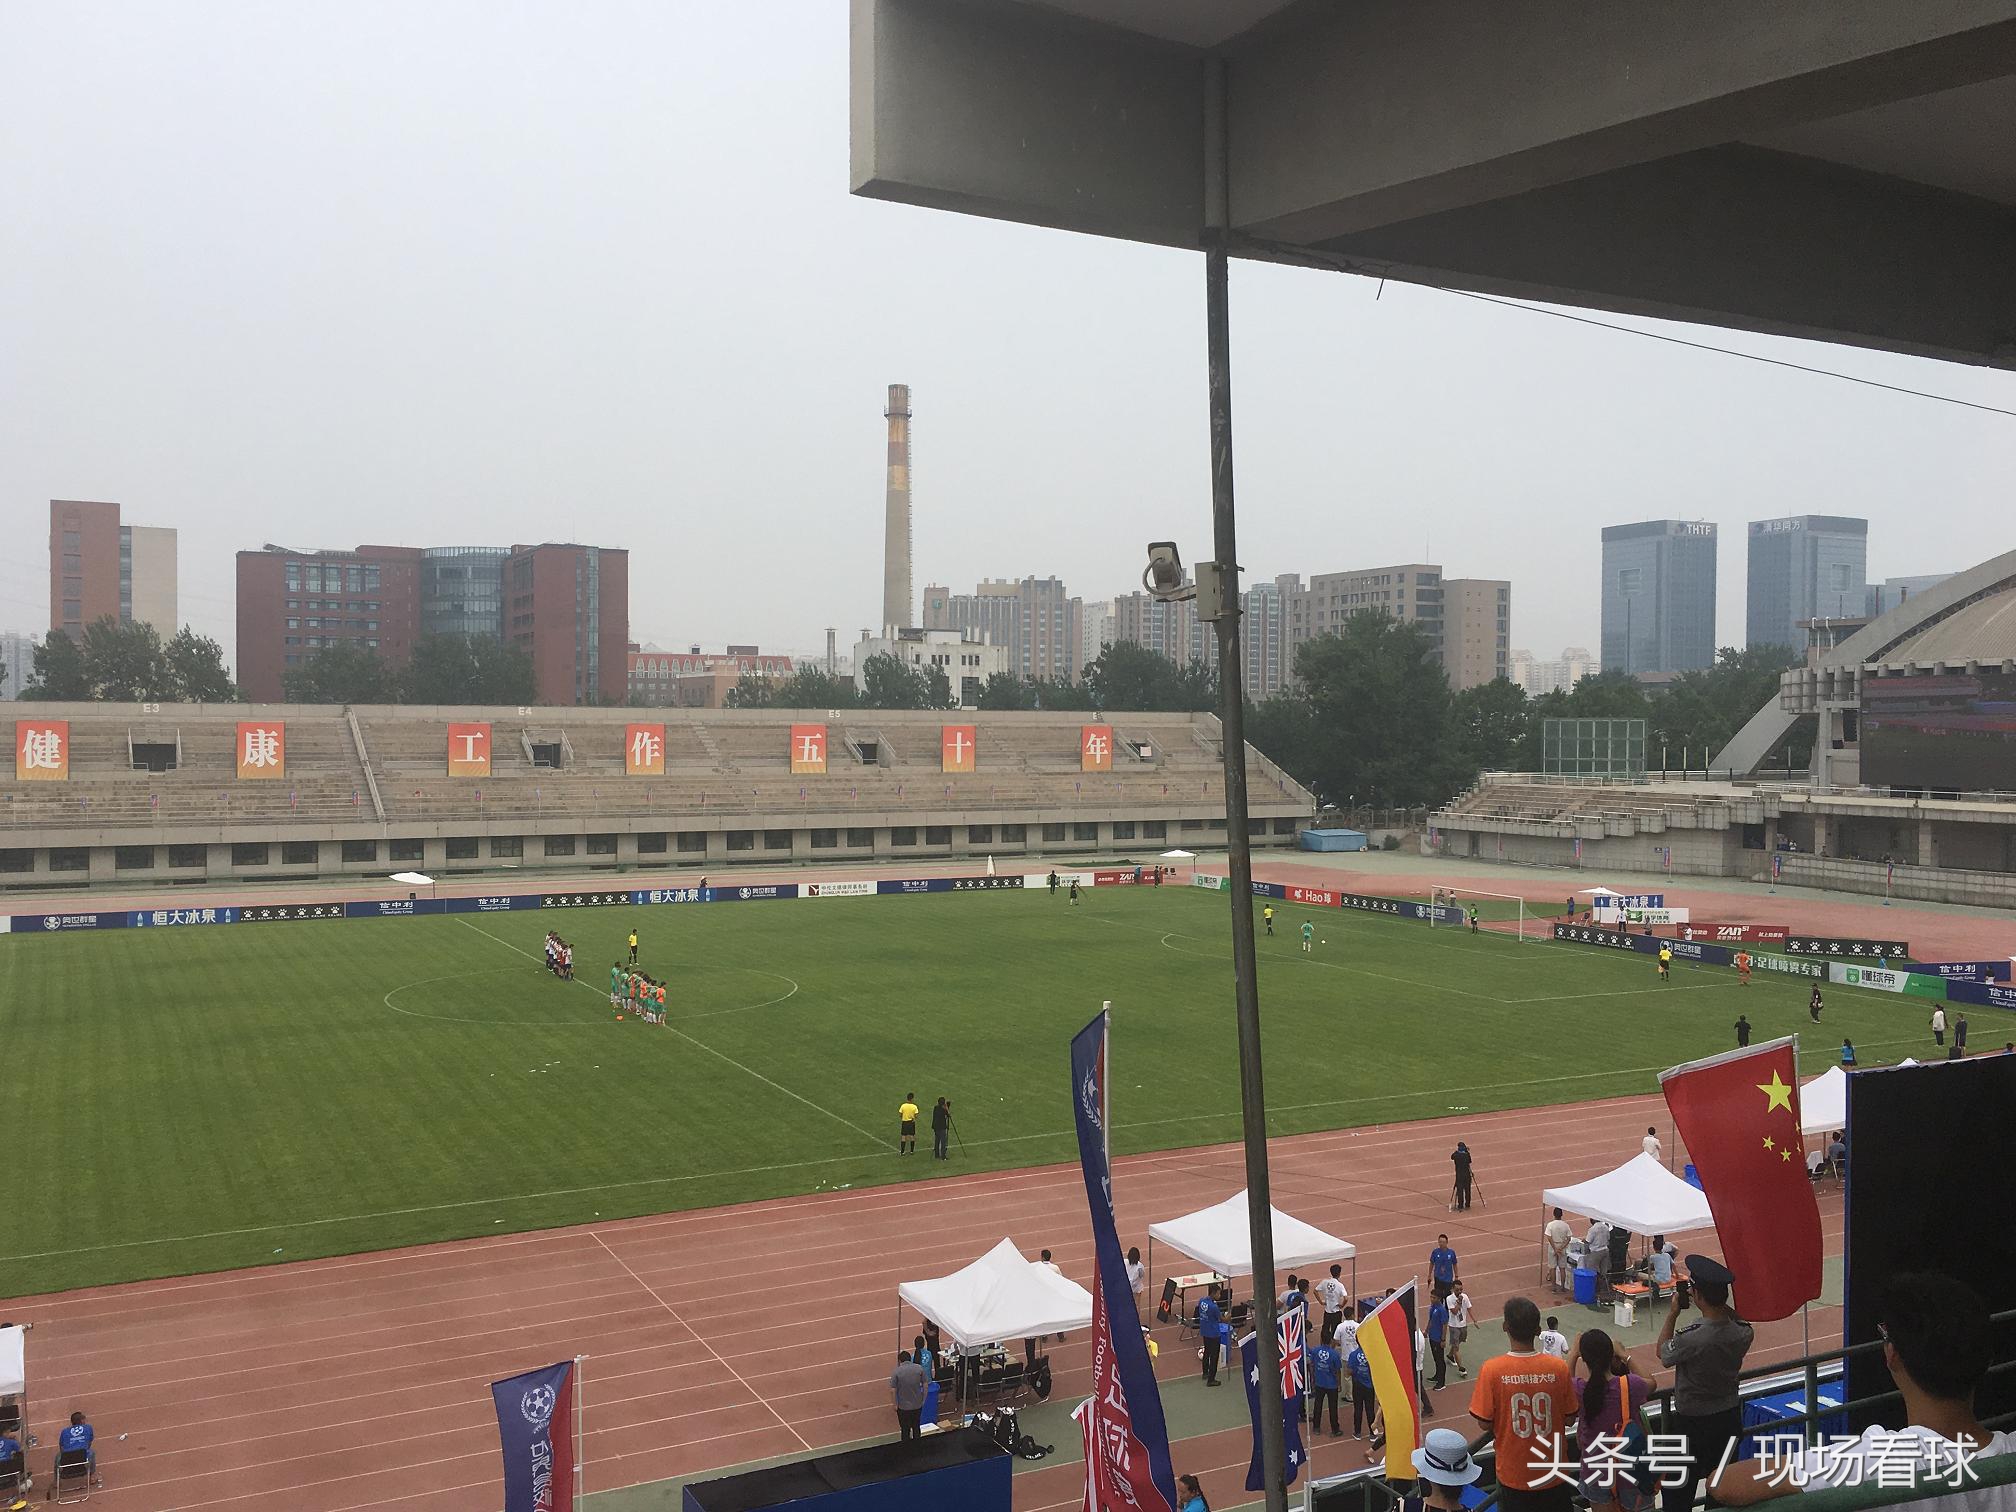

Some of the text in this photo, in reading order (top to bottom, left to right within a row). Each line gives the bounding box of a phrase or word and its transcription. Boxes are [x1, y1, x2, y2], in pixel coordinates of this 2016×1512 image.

[1686, 524, 1711, 535] THTF
[143, 704, 160, 712] E3
[829, 710, 841, 718] E5
[22, 729, 1109, 770] 健 康 工 作 五 十 年
[650, 889, 699, 904] 恒大冰泉
[1305, 890, 1323, 903] Hao
[152, 909, 216, 926] 恒大冰泉
[1939, 964, 1976, 973] 信中利
[1862, 969, 1895, 984] 懂球帝
[1501, 1374, 1556, 1385] 华中科技大学
[1510, 1391, 1553, 1439] 69
